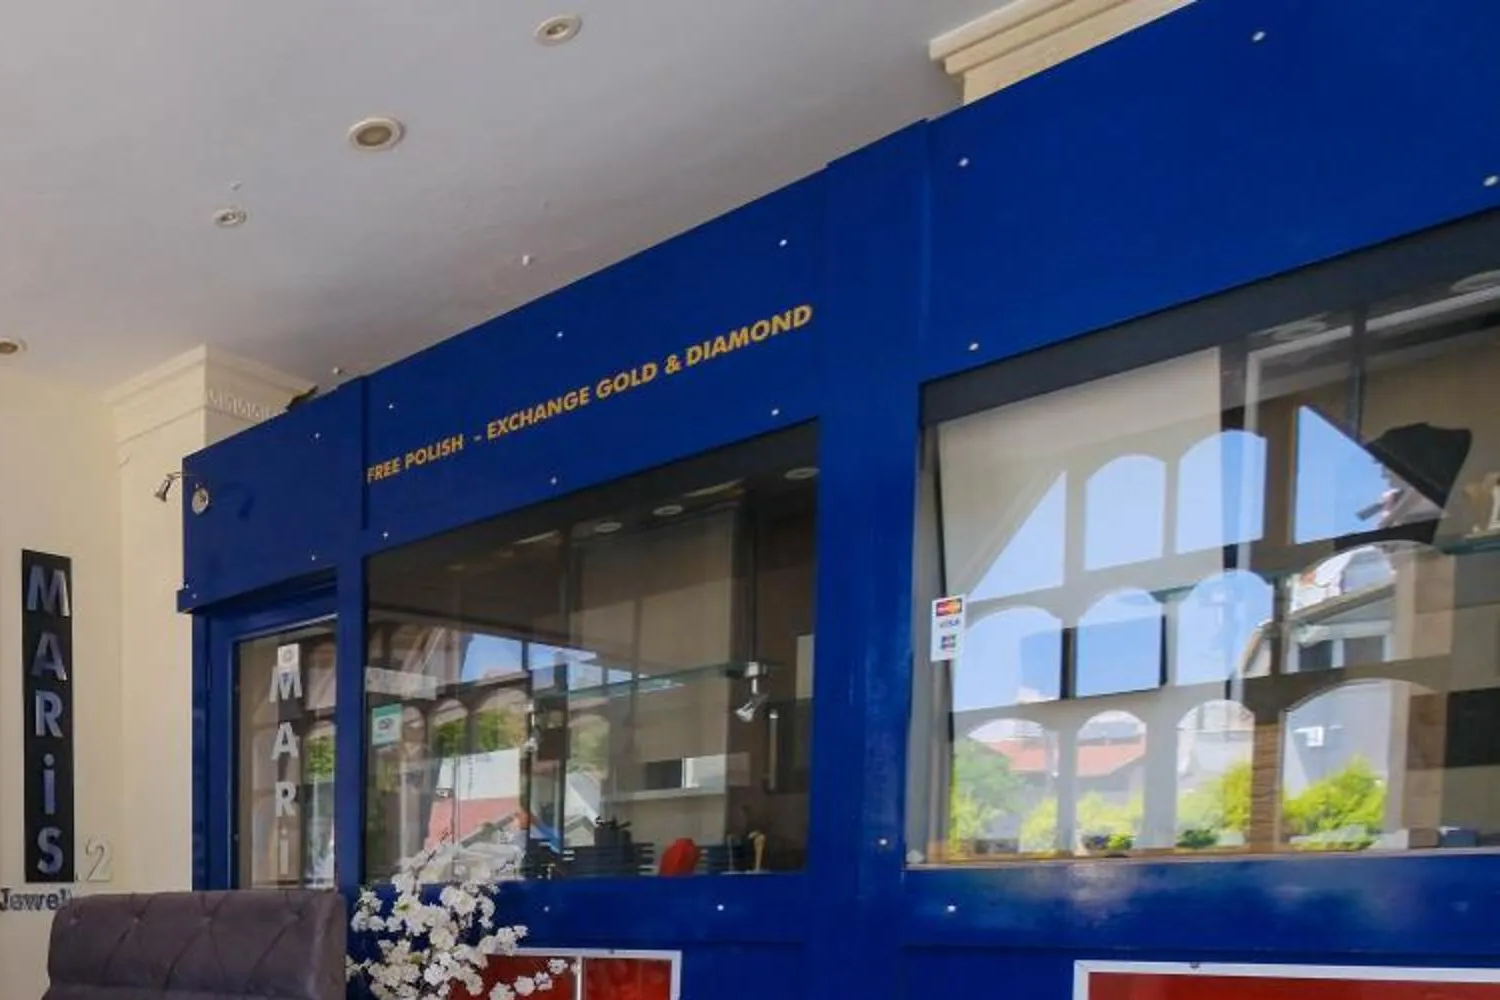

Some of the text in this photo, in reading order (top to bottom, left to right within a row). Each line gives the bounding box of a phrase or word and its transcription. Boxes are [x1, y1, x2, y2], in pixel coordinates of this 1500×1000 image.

[367, 457, 401, 482] FREE
[405, 434, 464, 470] POLISH
[487, 387, 589, 439] EXCHANGE
[597, 362, 657, 400] GOLD
[665, 355, 681, 376] &
[686, 305, 813, 367] DIAMOND
